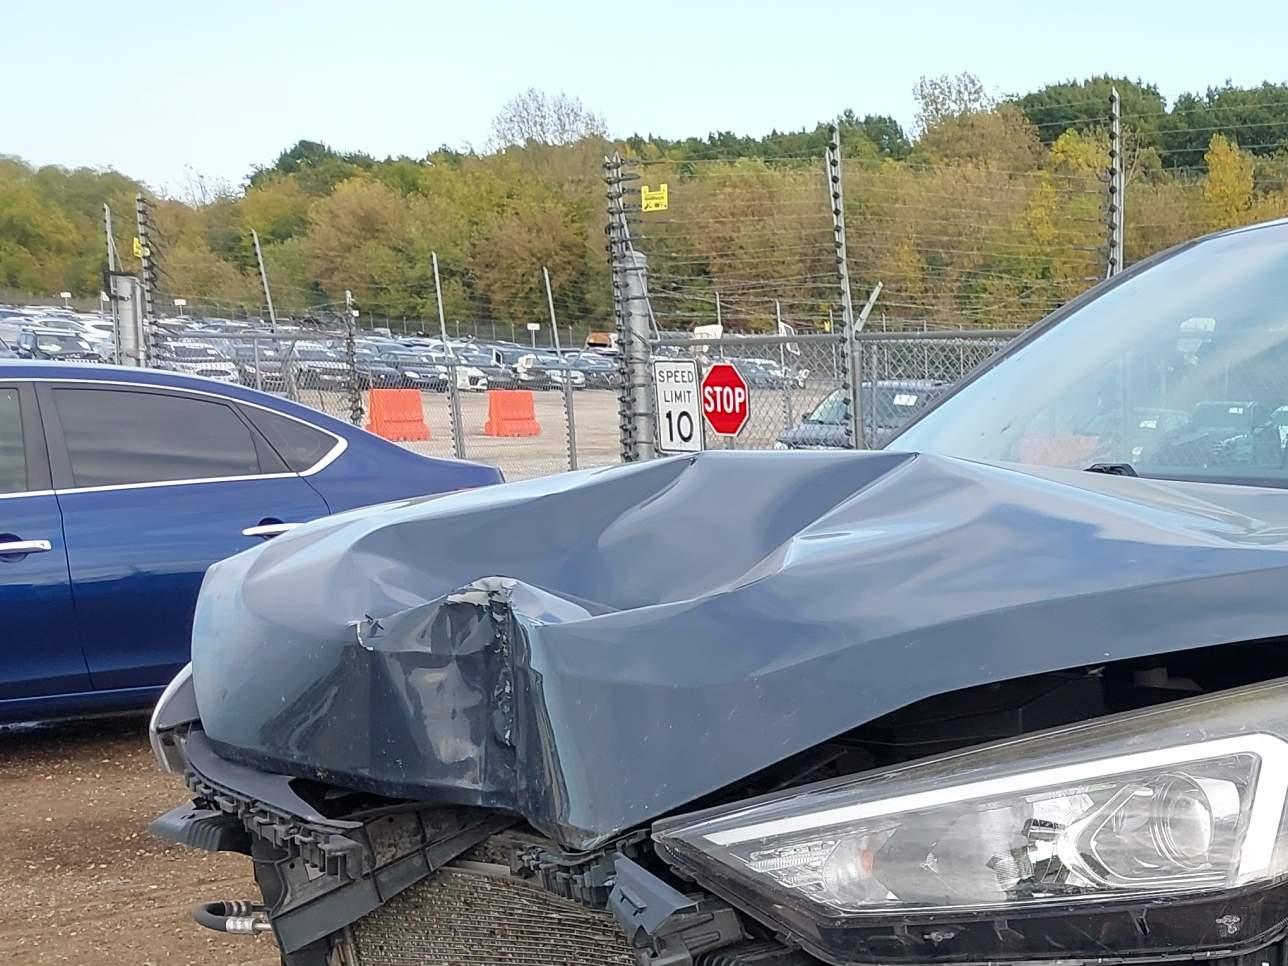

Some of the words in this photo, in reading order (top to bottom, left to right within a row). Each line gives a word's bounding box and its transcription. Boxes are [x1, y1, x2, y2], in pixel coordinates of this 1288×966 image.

[658, 370, 694, 384] SPEED
[663, 390, 692, 403] LIMIT
[704, 386, 745, 414] STOP
[665, 410, 694, 443] 10
